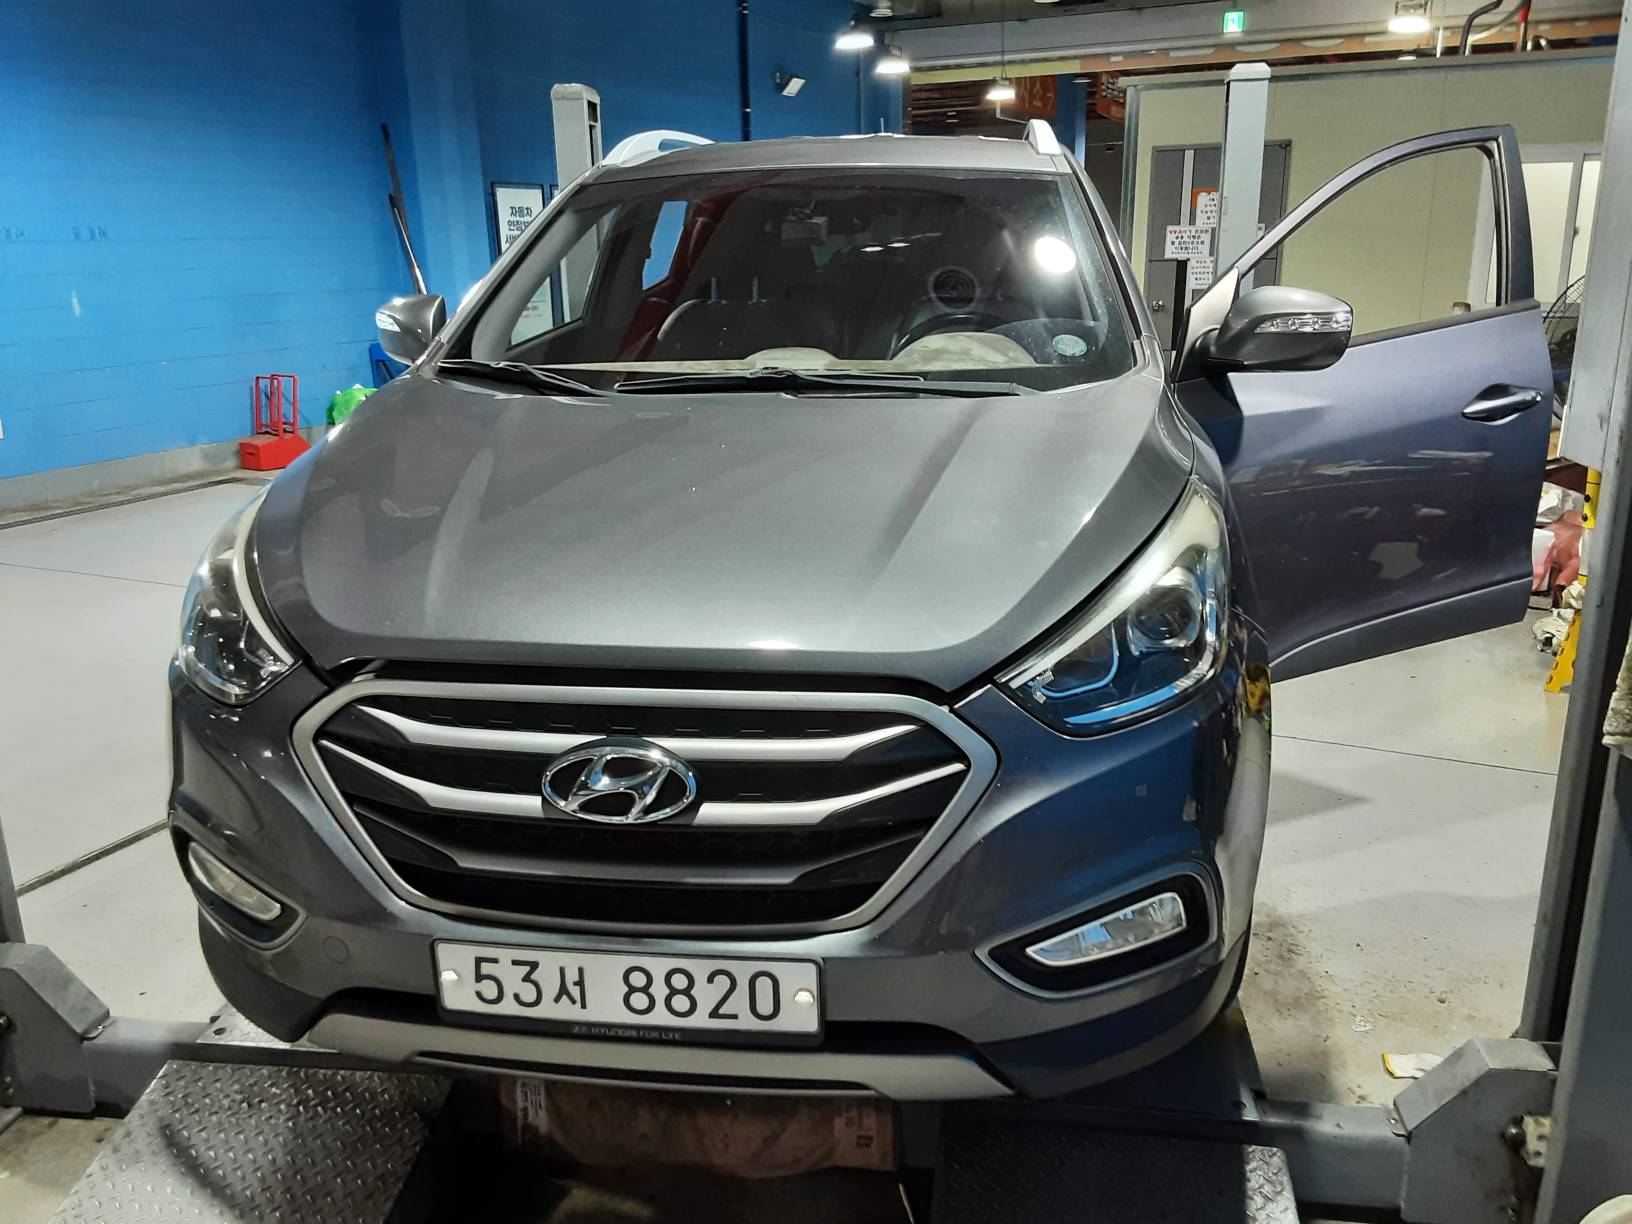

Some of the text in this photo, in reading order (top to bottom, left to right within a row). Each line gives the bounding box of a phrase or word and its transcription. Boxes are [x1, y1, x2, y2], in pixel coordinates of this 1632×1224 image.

[509, 206, 532, 218] 자동차
[473, 956, 782, 1021] 53서 8820
